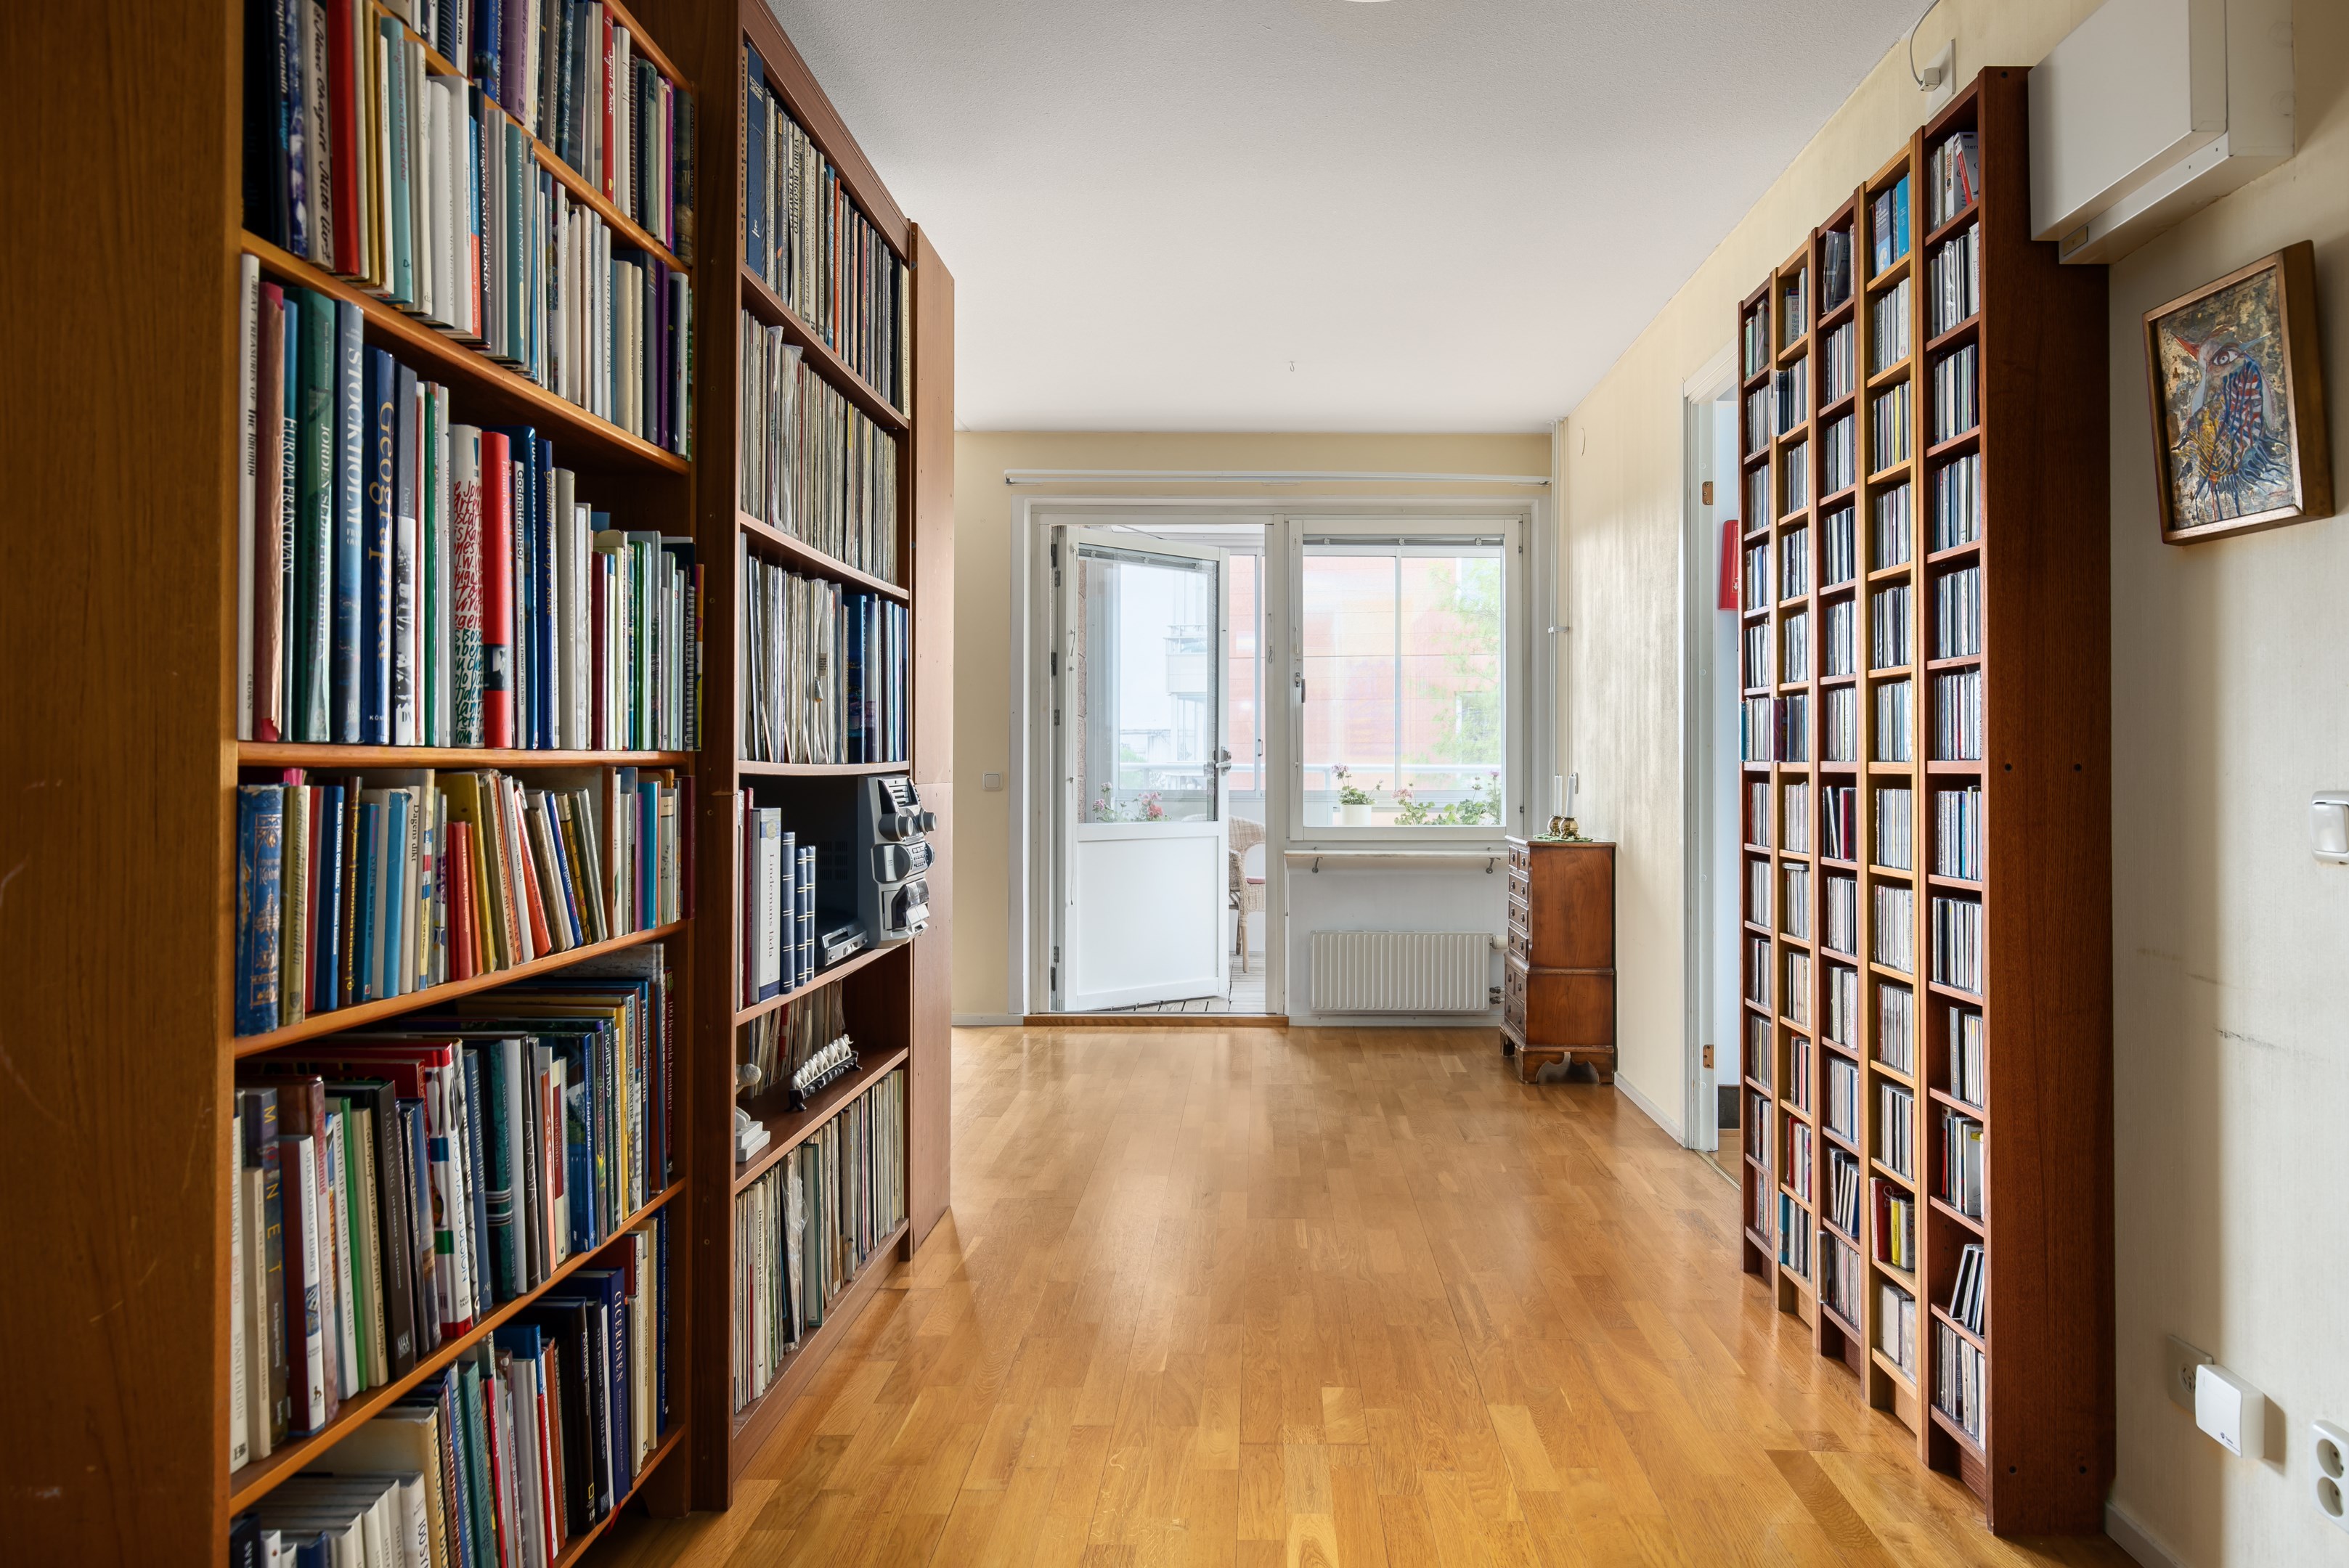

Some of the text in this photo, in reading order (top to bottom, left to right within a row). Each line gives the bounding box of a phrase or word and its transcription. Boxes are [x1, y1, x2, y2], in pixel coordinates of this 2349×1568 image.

[566, 55, 571, 68] DU
[566, 93, 570, 106] DE
[318, 160, 330, 209] Mitt
[250, 387, 256, 401] OF
[283, 418, 298, 480] EUROPA
[320, 424, 331, 489] JORDEN
[346, 348, 362, 524] STOCKHOLM
[319, 494, 330, 538] SEDD
[282, 531, 296, 573] OVAN
[410, 804, 420, 840] Dagens
[335, 1120, 346, 1197] BERÄTTELSER
[385, 1111, 396, 1188] FÅGELSÅNG
[526, 1121, 537, 1203] ARABIA
[264, 1105, 282, 1273] MONET
[340, 1199, 346, 1216] OM
[459, 1228, 468, 1281] DESIGN
[614, 1290, 624, 1383] CICERONEN
[452, 1386, 467, 1490] HUNDRA SVENSKA
[471, 1388, 487, 1490] Nyklassicismen
[481, 1502, 492, 1551] Sverige
[418, 1519, 428, 1544] 100
